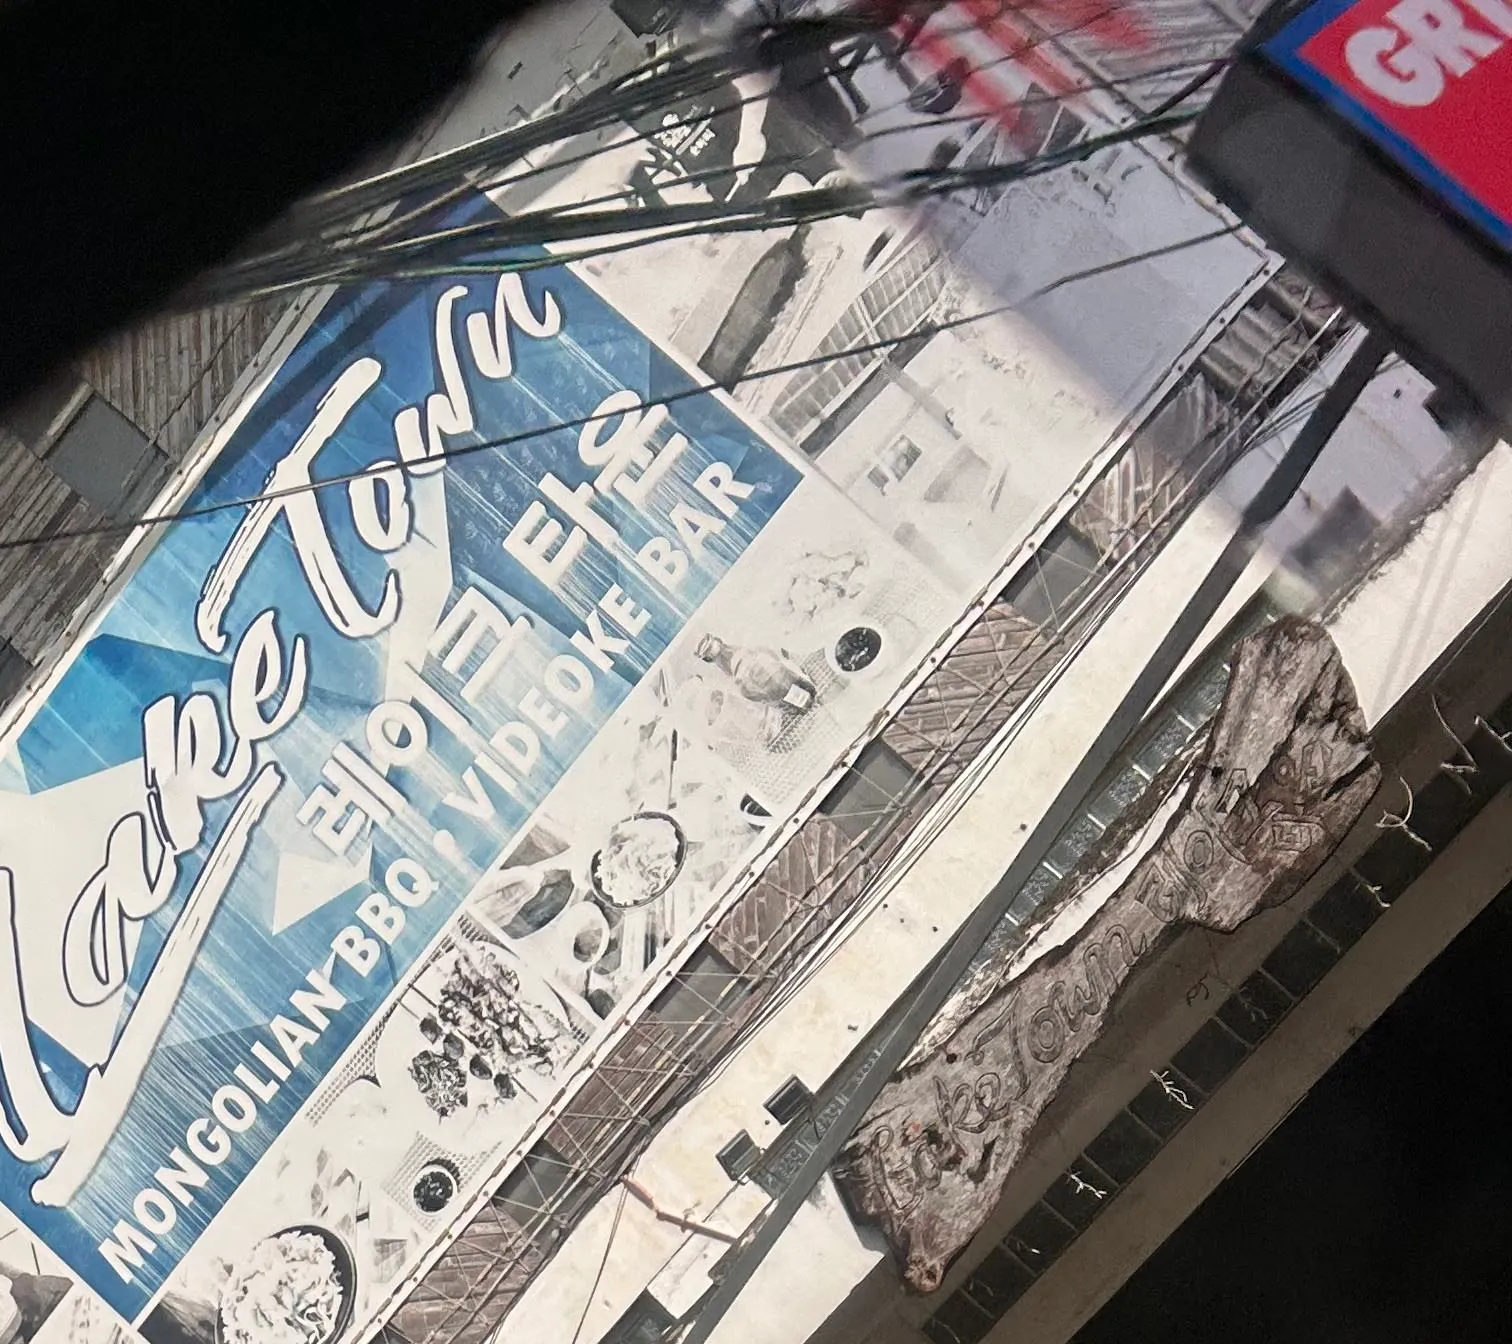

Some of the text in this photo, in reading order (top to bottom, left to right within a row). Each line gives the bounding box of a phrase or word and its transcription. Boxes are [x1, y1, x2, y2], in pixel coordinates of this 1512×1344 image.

[198, 270, 564, 650] Town
[295, 388, 689, 858] 레이크 타운
[97, 461, 756, 1286] MONGOLIAN BBQ VIDEOKE BAR
